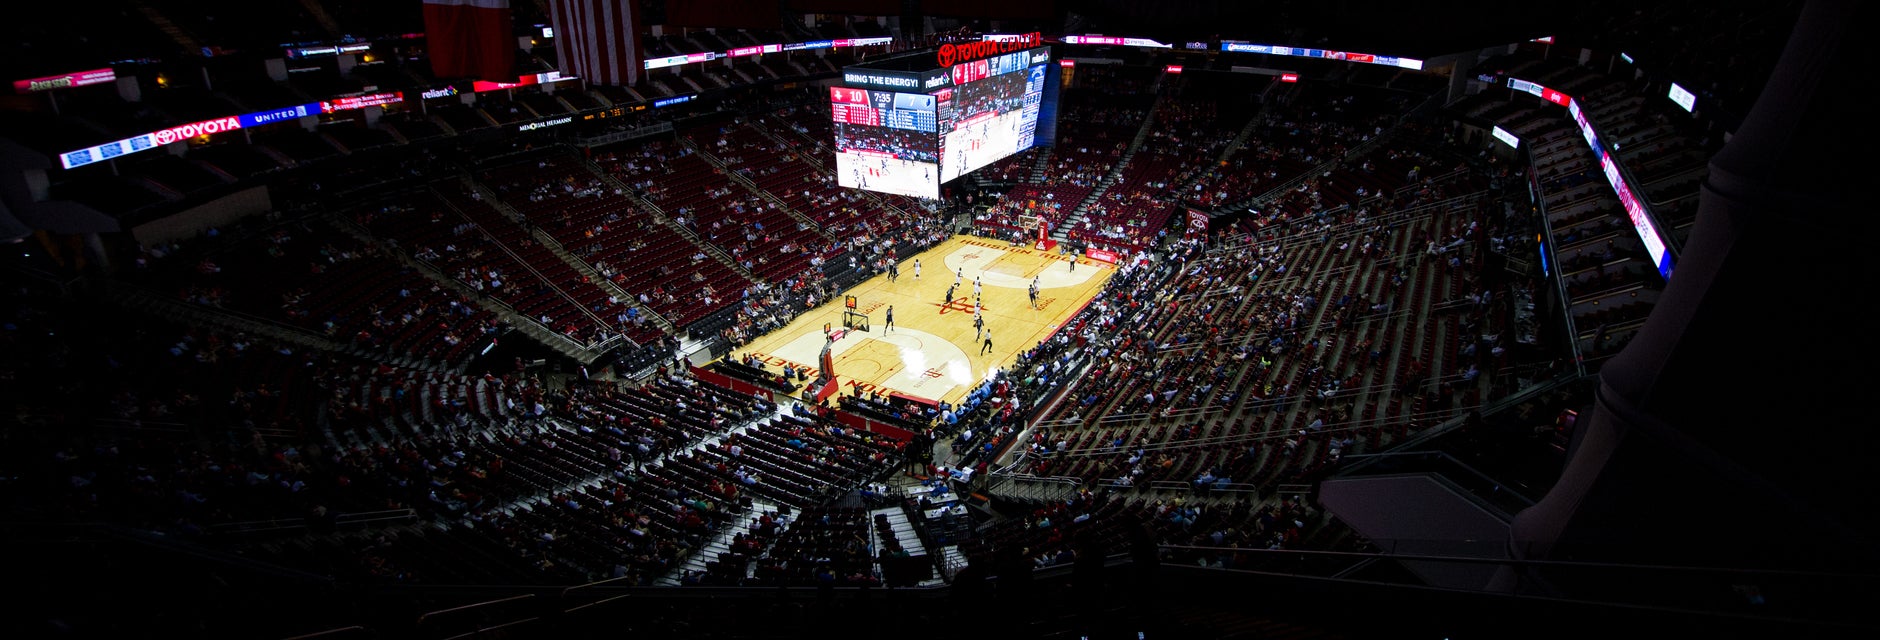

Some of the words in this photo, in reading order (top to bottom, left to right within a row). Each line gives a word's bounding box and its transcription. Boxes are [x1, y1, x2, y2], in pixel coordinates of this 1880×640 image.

[956, 39, 999, 61] TOYOTA
[1000, 32, 1041, 53] CENTER
[845, 73, 868, 84] BRING
[868, 75, 884, 85] THE
[884, 77, 918, 88] ENERGY!
[925, 76, 944, 88] reliant
[422, 88, 449, 99] reliant
[849, 91, 863, 103] 10
[874, 92, 891, 103] 7:35
[908, 95, 916, 107] 7
[255, 109, 295, 123] UNITED
[546, 116, 572, 127] HERMANN
[173, 117, 241, 140] TOYOTA
[1188, 210, 1208, 223] TOYOTA
[960, 239, 1032, 255] HOUSTON
